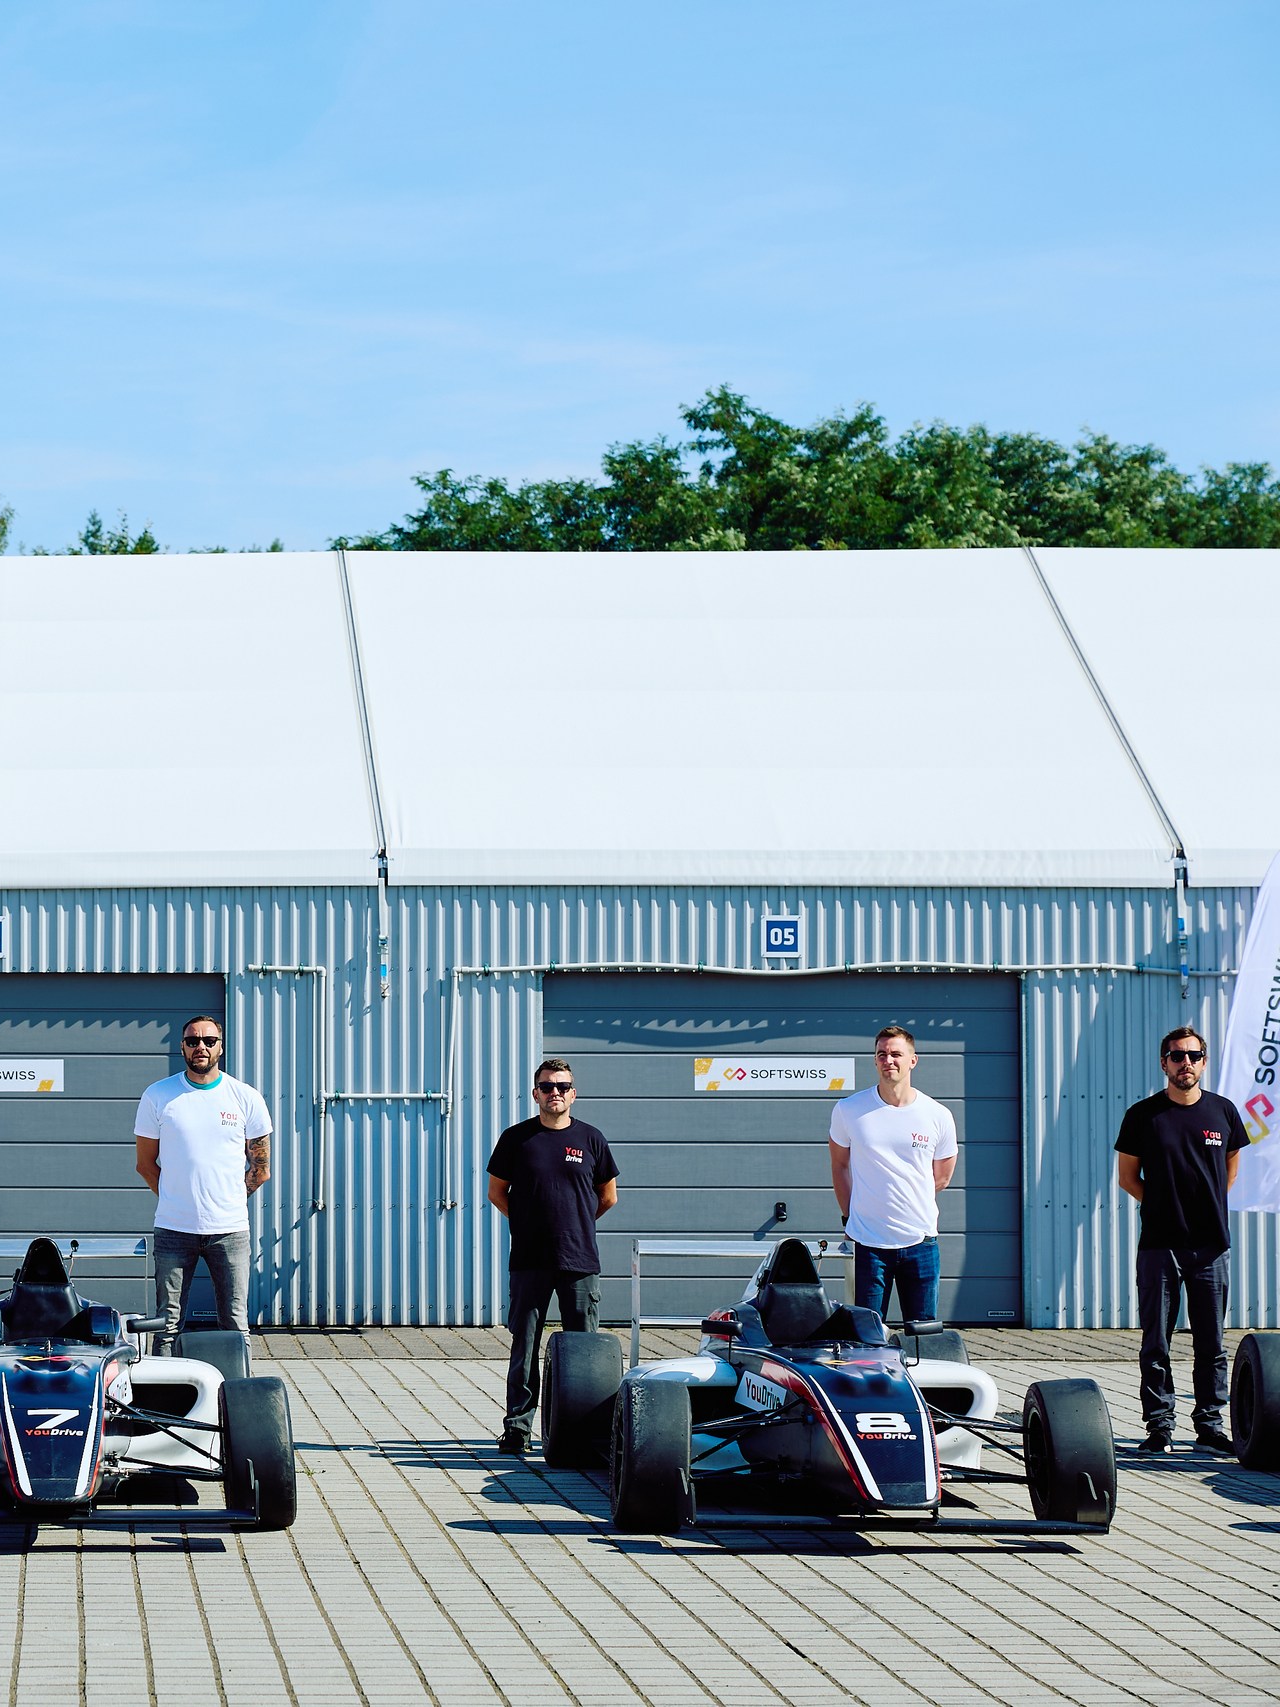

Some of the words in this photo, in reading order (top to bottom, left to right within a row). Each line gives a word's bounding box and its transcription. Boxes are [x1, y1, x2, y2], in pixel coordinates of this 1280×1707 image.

[770, 927, 795, 946] 05
[750, 1069, 827, 1080] SOFTSWISS
[220, 1112, 238, 1120] You
[221, 1119, 238, 1127] Drive
[911, 1133, 929, 1142] You
[1202, 1130, 1221, 1139] You
[1204, 1138, 1223, 1146] Drive
[565, 1147, 583, 1157] You
[565, 1155, 583, 1163] Drive
[27, 1408, 80, 1430] 7
[854, 1412, 911, 1433] 8
[25, 1428, 84, 1437] YouDrive
[856, 1432, 917, 1440] YouDrive
